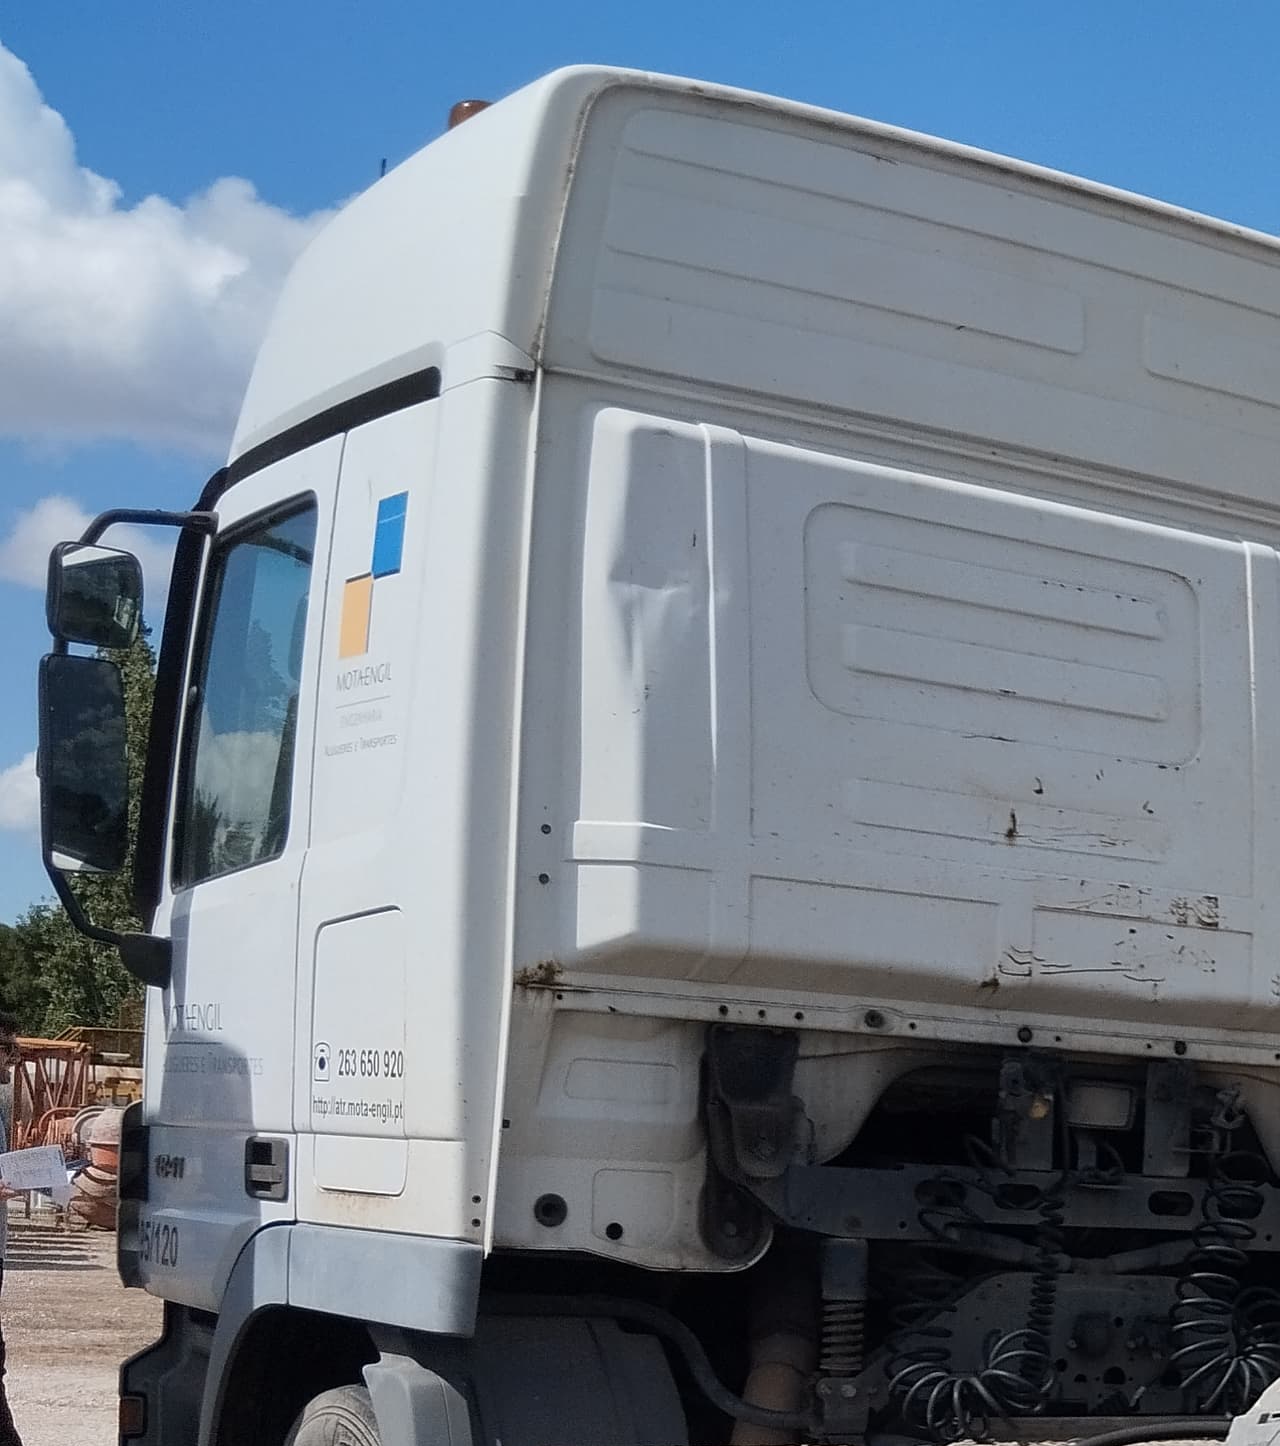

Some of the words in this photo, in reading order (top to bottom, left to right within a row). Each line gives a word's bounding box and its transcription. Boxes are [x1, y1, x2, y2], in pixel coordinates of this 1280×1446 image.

[338, 1049, 357, 1077] 263
[360, 1049, 380, 1078] 650
[383, 1050, 404, 1079] 920
[313, 1095, 404, 1124] http://atr.mota-engil.pt
